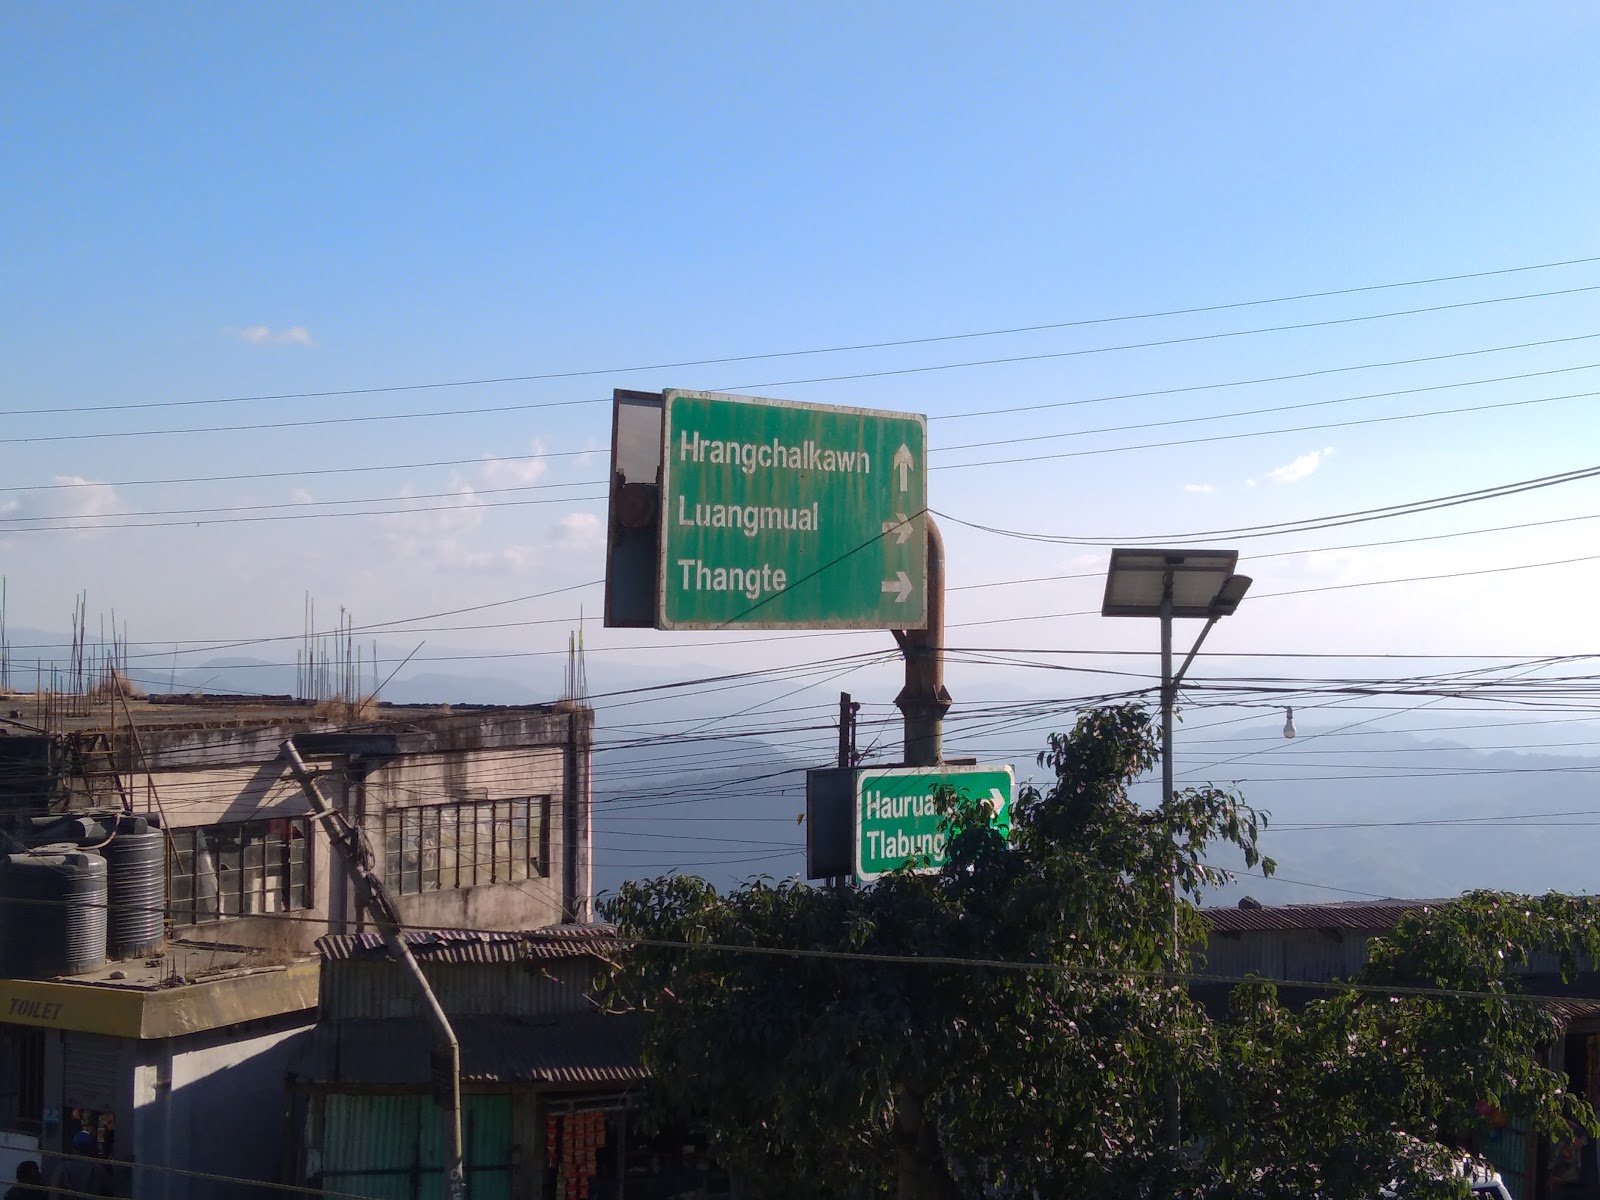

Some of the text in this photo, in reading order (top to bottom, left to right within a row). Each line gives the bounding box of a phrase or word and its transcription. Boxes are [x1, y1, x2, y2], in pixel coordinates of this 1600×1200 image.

[679, 429, 870, 475] Hrangchalkawn
[678, 495, 819, 537] Luangmual
[677, 559, 787, 600] Thangte
[866, 789, 952, 820] Haurua
[866, 828, 946, 862] Tlabung
[8, 997, 65, 1021] TOILET
